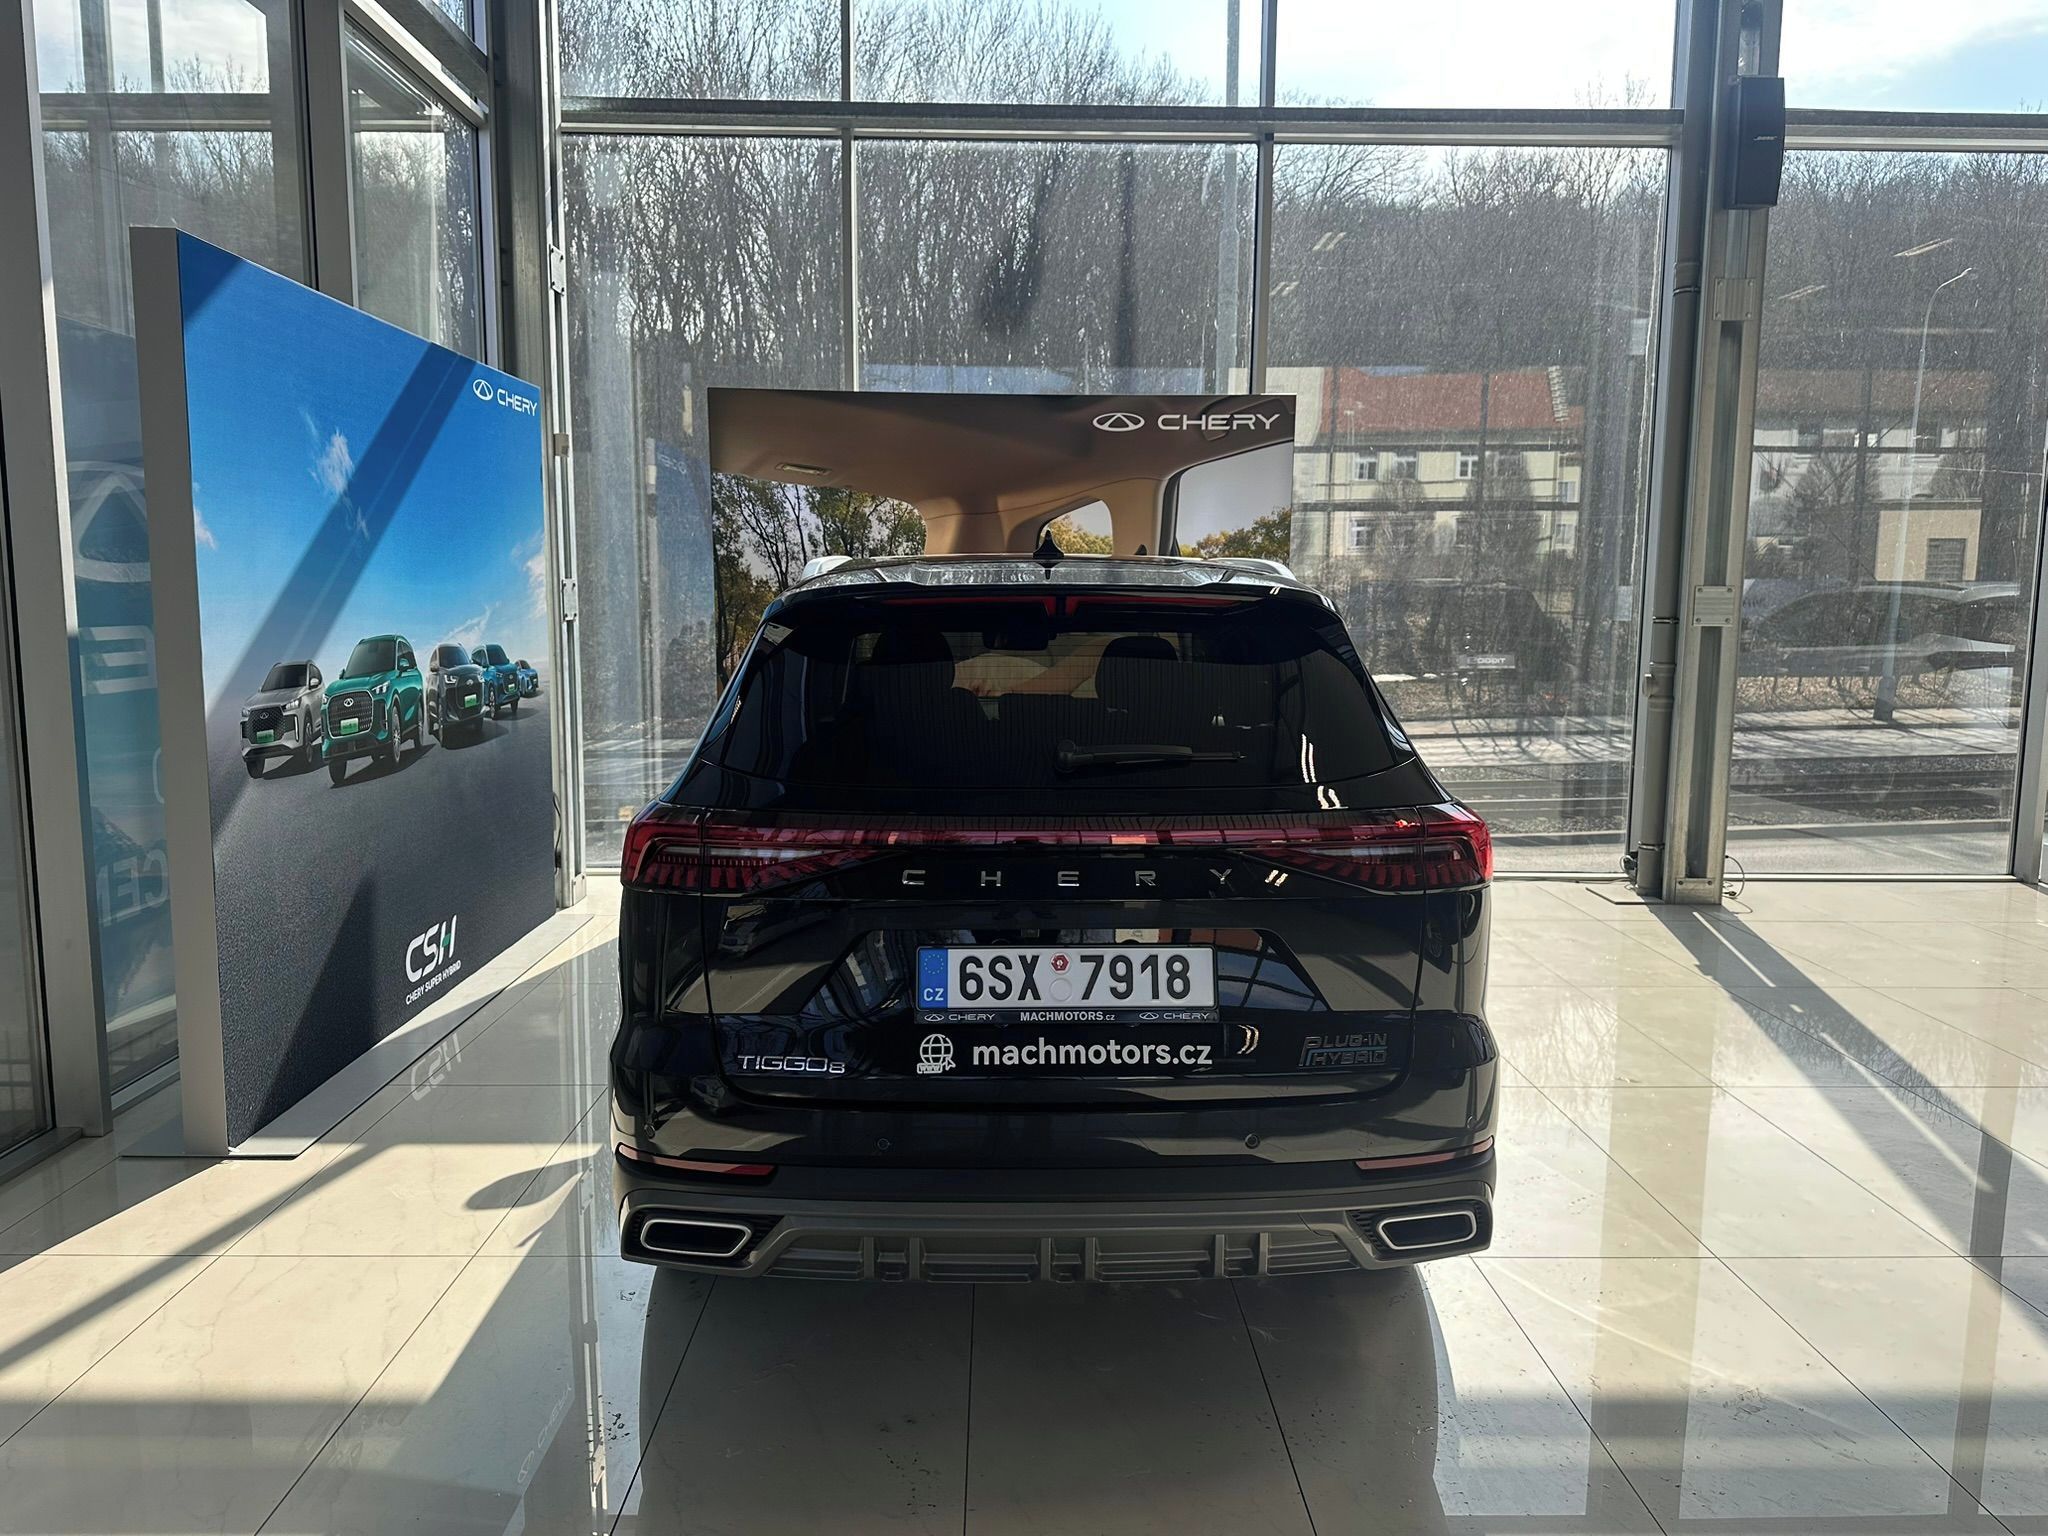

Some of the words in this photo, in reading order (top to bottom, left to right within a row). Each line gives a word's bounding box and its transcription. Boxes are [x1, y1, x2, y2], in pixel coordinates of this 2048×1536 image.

[497, 388, 537, 416] CHERY
[1157, 413, 1280, 430] CHERY
[902, 868, 1233, 887] CHERY
[405, 914, 457, 983] CSH
[405, 984, 425, 1005] CHERY
[424, 974, 443, 992] SUPER
[442, 960, 462, 980] HYBRID
[958, 954, 1042, 1001] 6SX
[1080, 954, 1191, 1001] 7918
[923, 988, 944, 1001] CZ
[948, 1013, 996, 1021] CHERY
[1020, 1011, 1116, 1022] MACHMOTORS.cz
[1163, 1012, 1210, 1020] CHERY
[973, 1037, 1214, 1065] machmotors.cz
